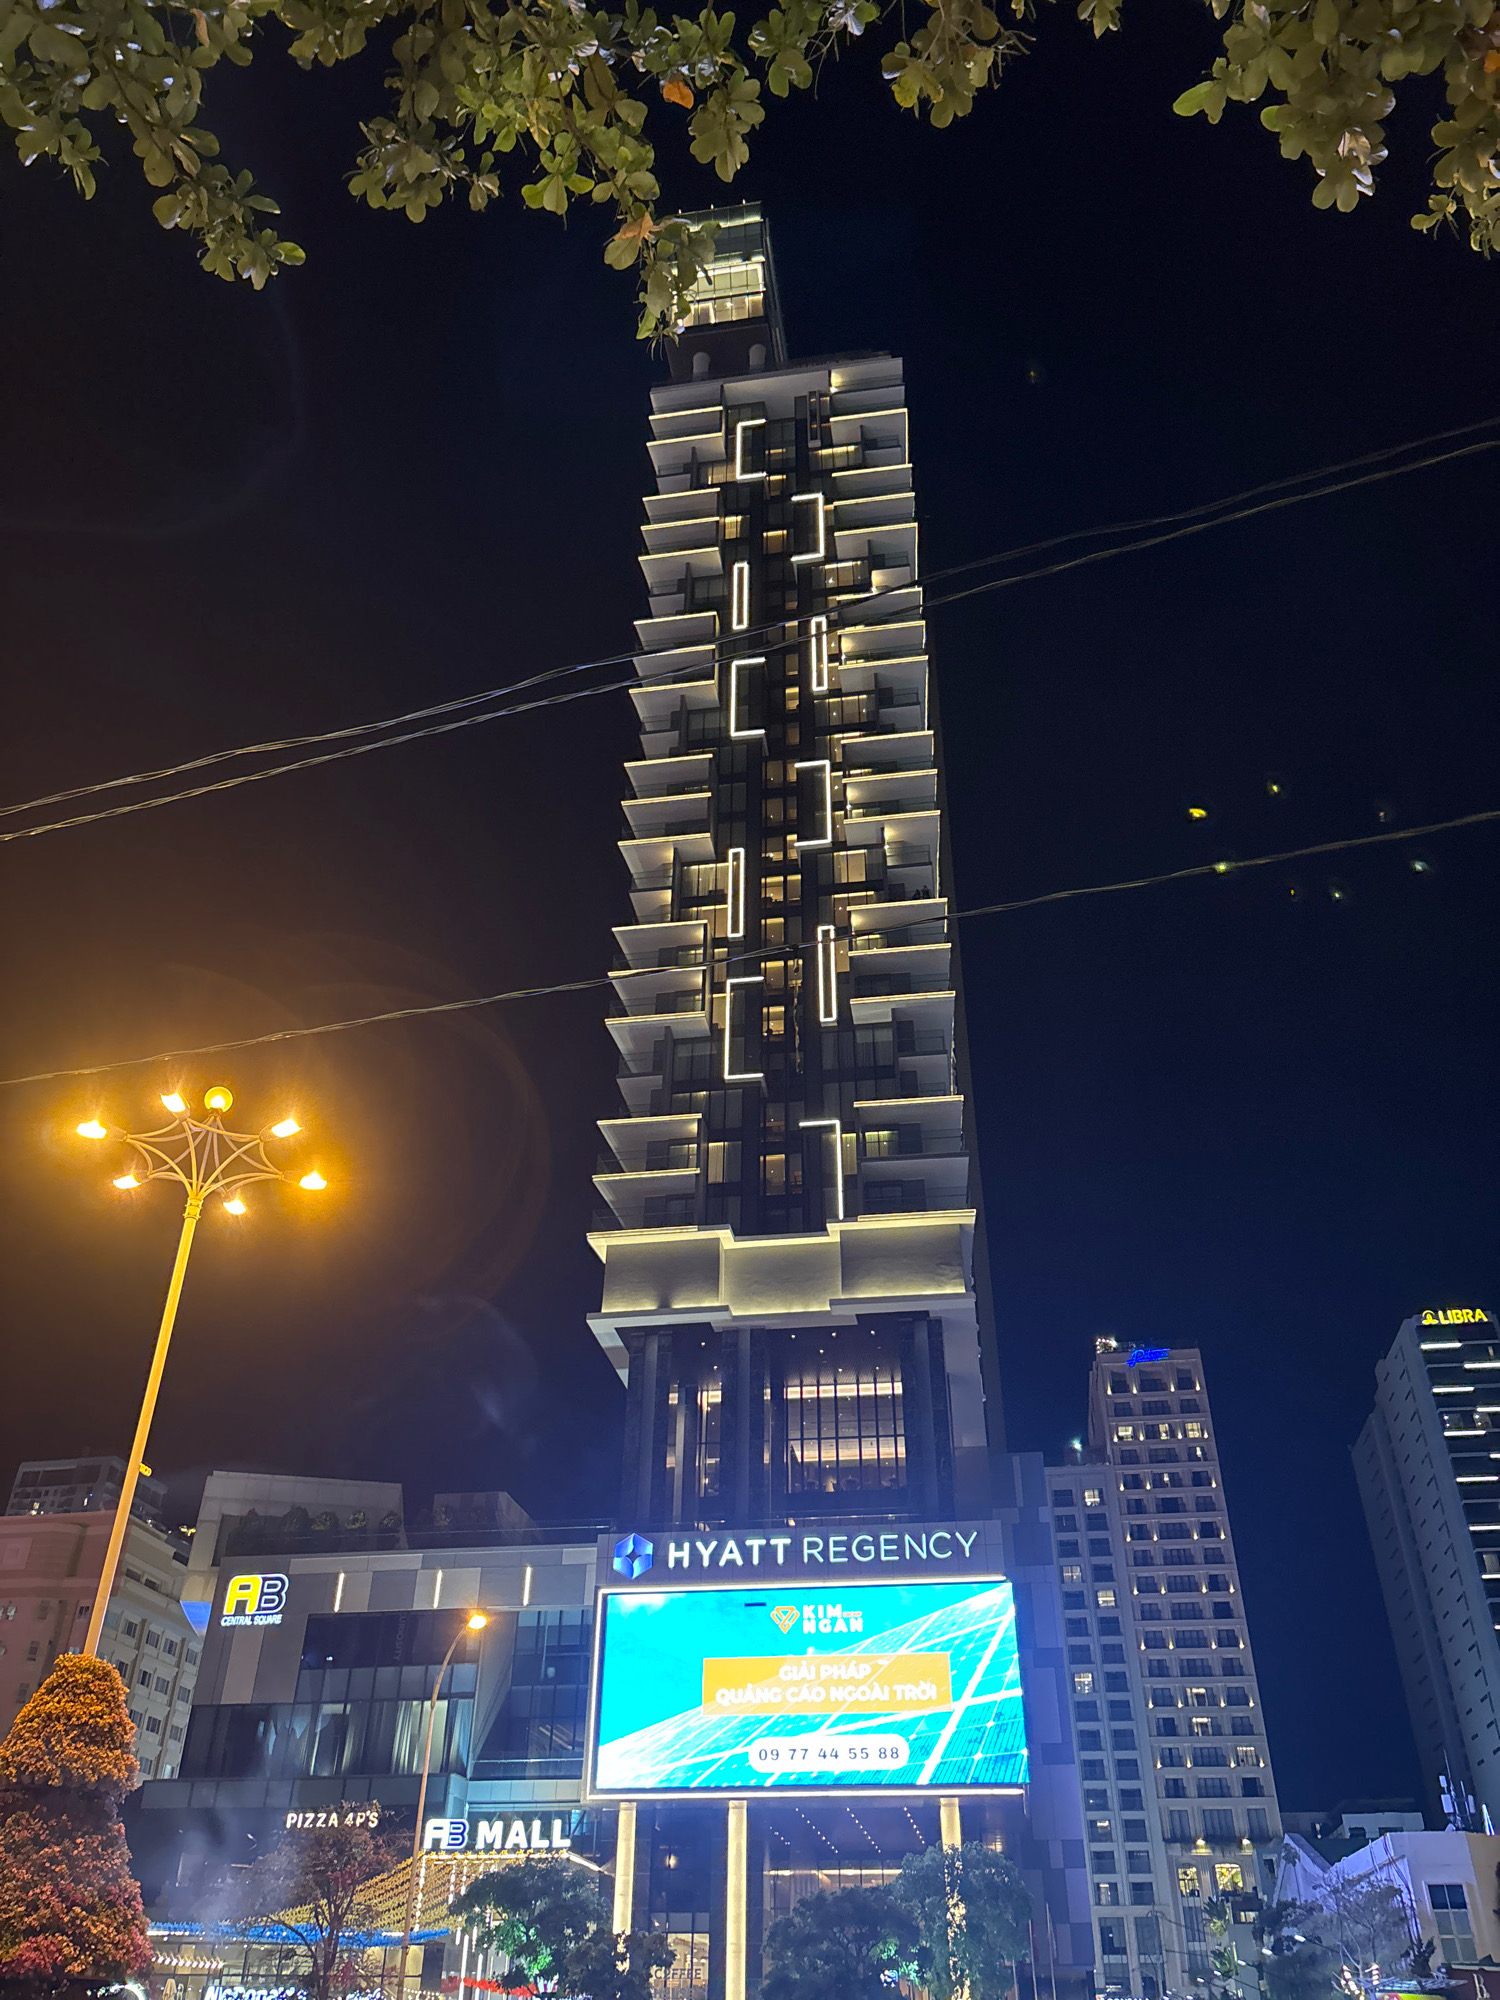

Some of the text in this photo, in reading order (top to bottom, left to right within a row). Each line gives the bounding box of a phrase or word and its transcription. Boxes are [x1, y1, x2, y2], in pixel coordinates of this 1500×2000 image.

[1438, 1308, 1488, 1325] LIBRA
[667, 1531, 978, 1569] HYATT REGENCY
[223, 1573, 289, 1615] AB
[221, 1614, 283, 1626] CENTRAL SQUARE
[802, 1603, 842, 1619] KIM
[802, 1617, 864, 1634] NGAN
[819, 1660, 872, 1680] PHÁP
[786, 1683, 826, 1702] CÁO
[829, 1682, 889, 1703] NGOÀI
[758, 1747, 900, 1761] 09 77 44 55 88
[286, 1810, 378, 1829] PIZZA 4P'S
[423, 1818, 571, 1849] AB MALL
